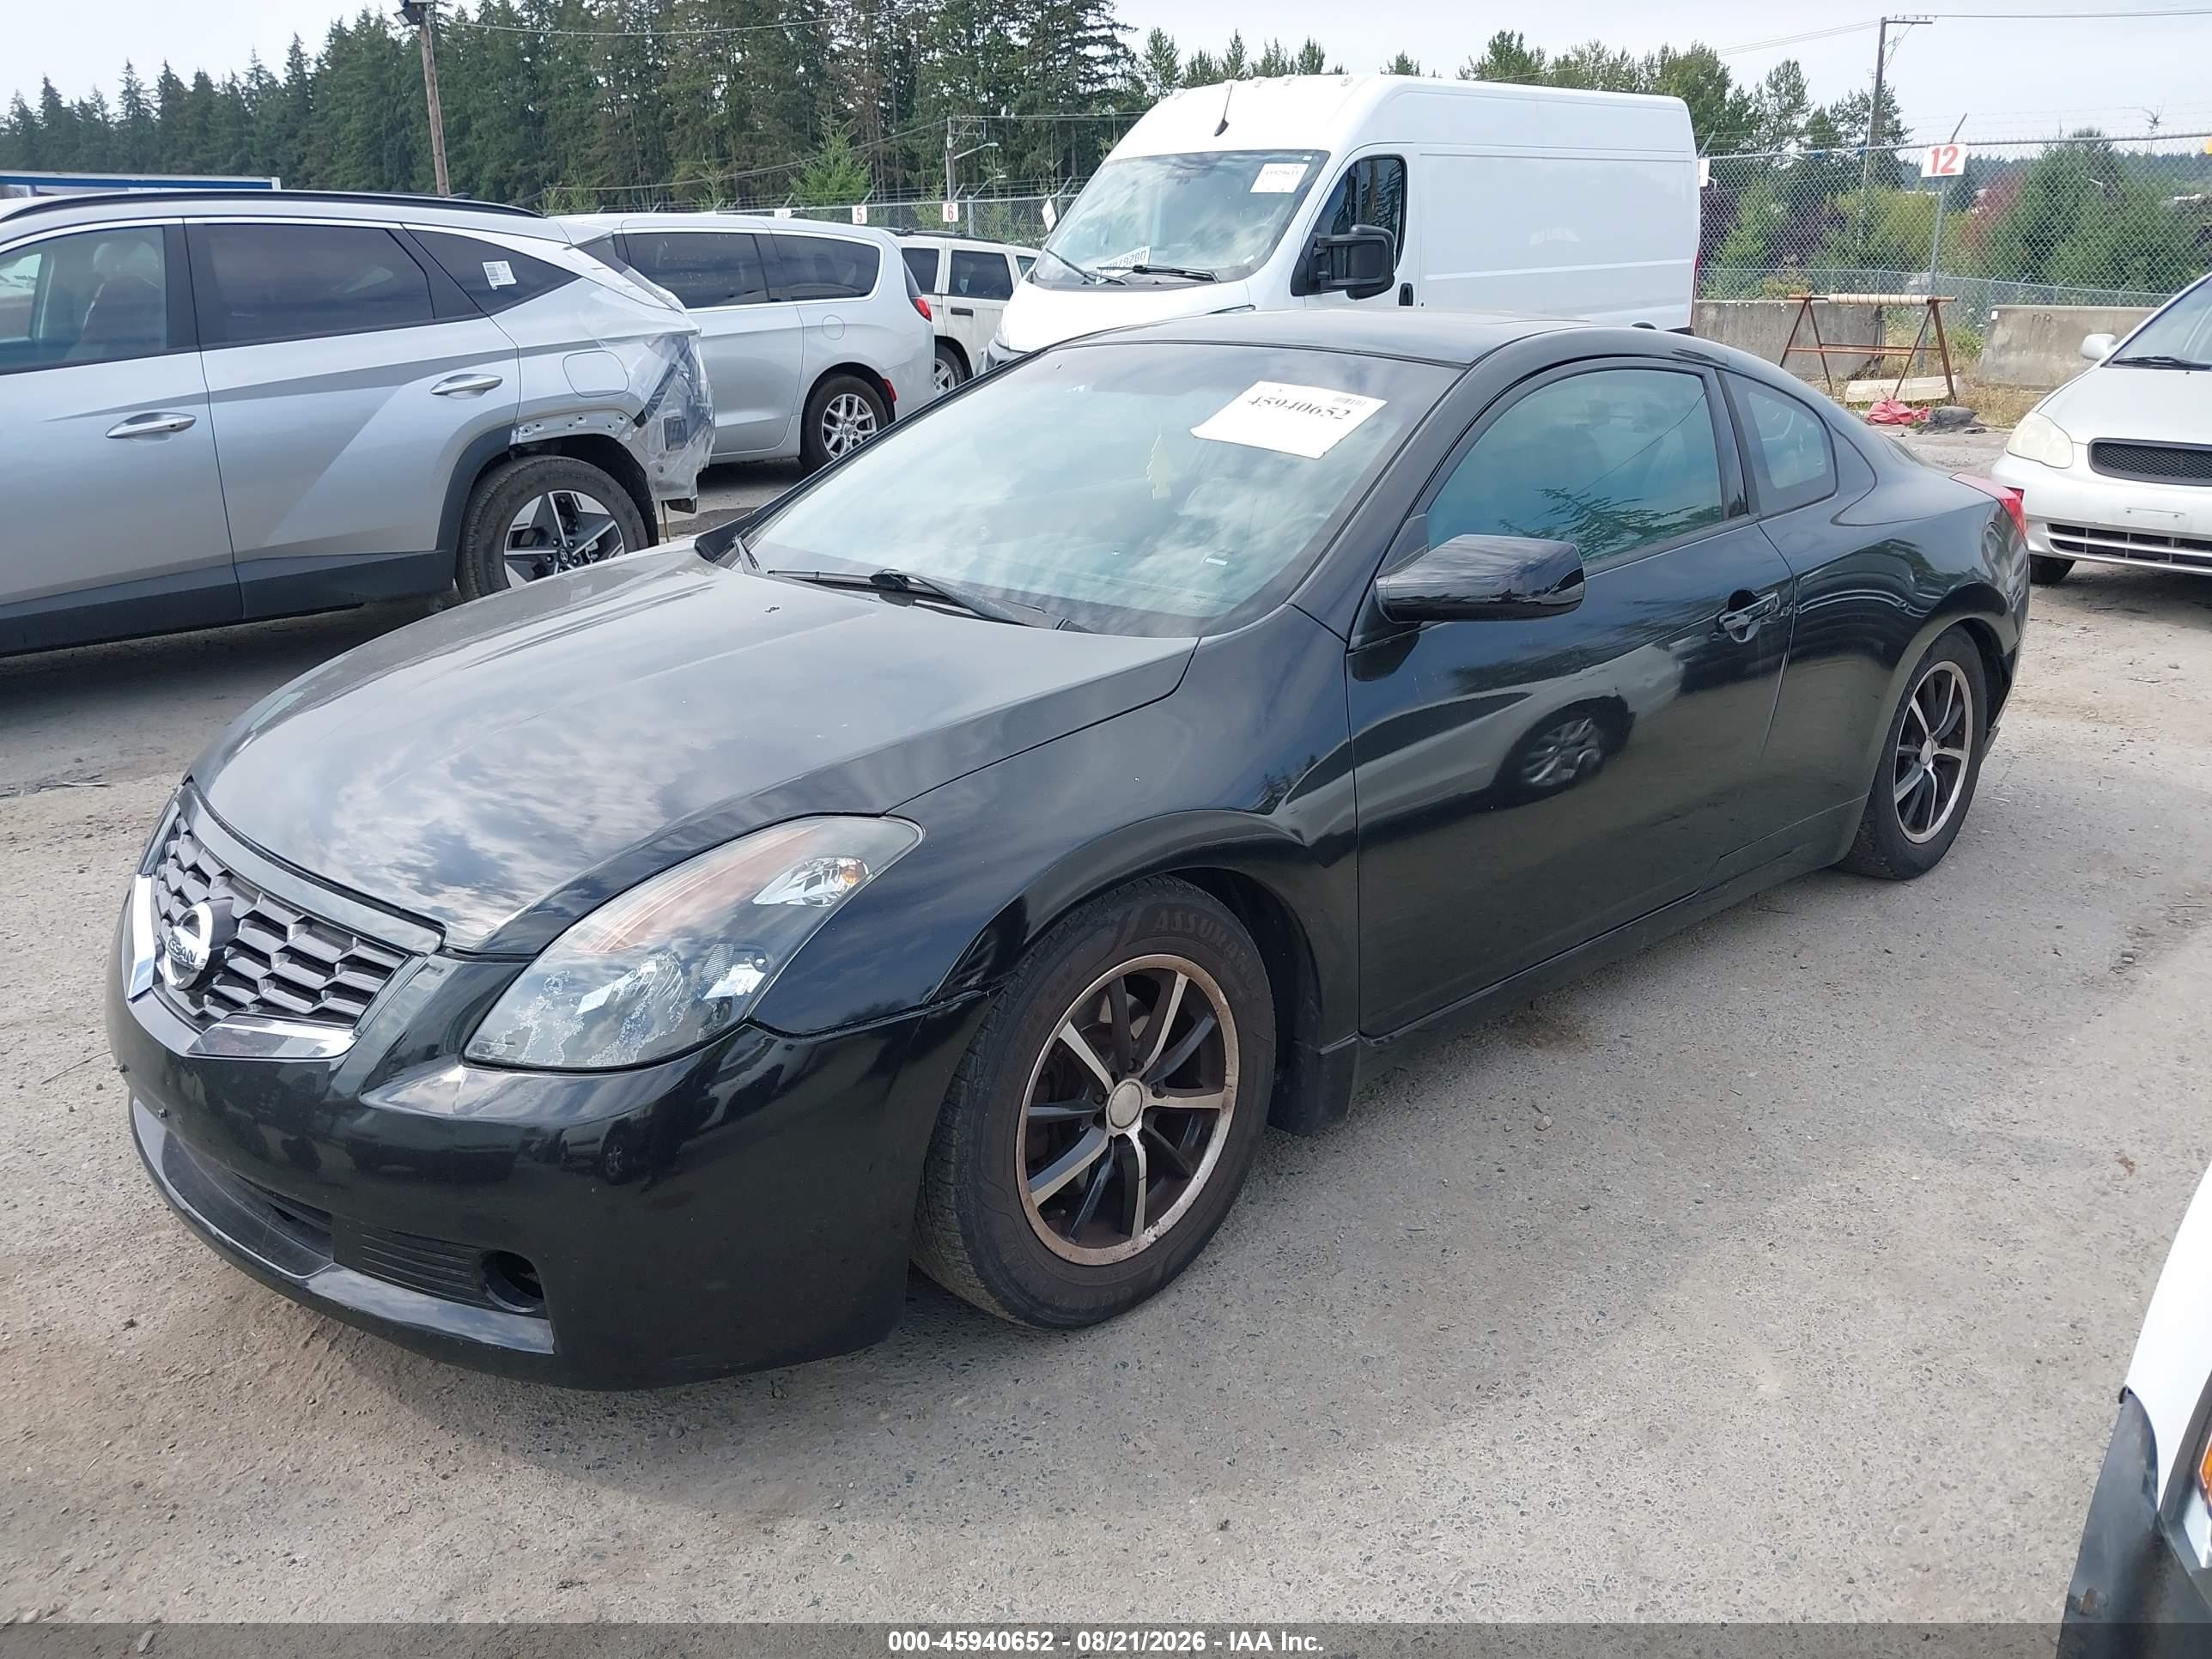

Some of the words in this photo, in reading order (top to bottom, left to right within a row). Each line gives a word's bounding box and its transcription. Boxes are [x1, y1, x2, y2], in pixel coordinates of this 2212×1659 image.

[1931, 145, 1959, 174] 12
[856, 206, 863, 222] 5
[947, 204, 954, 221] 6
[1247, 396, 1352, 420] 45940652
